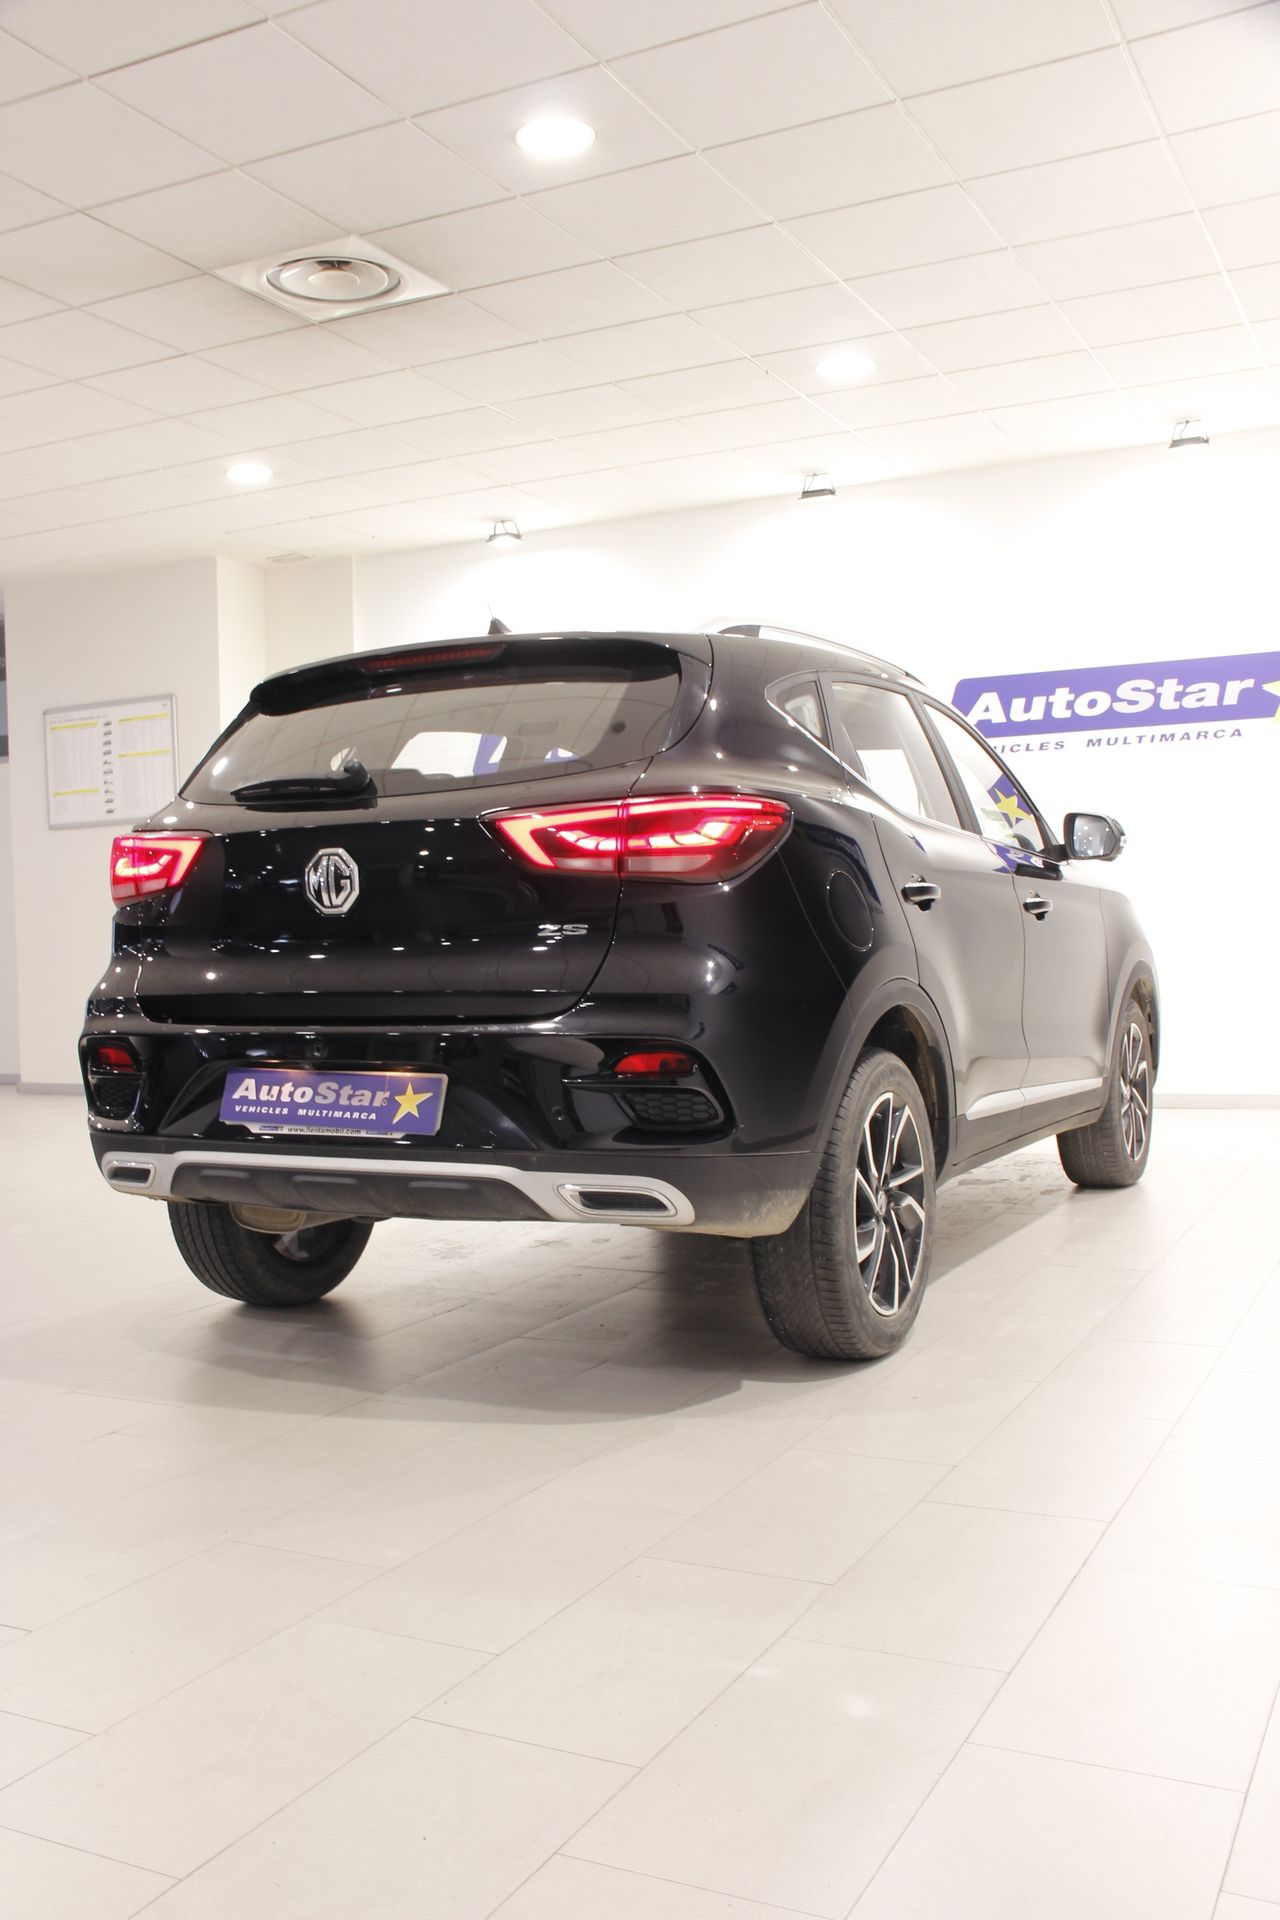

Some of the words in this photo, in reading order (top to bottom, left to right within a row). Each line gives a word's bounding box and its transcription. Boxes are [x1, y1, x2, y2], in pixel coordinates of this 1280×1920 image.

[965, 678, 1254, 724] AutoStar
[993, 740, 1065, 754] ICLES
[1086, 728, 1242, 748] MULTIMARCA
[308, 853, 352, 909] MG
[537, 924, 589, 937] ZS
[232, 1078, 390, 1107] AutoStar
[235, 1105, 289, 1115] VEHICLES
[297, 1109, 377, 1121] MULTIMARCA
